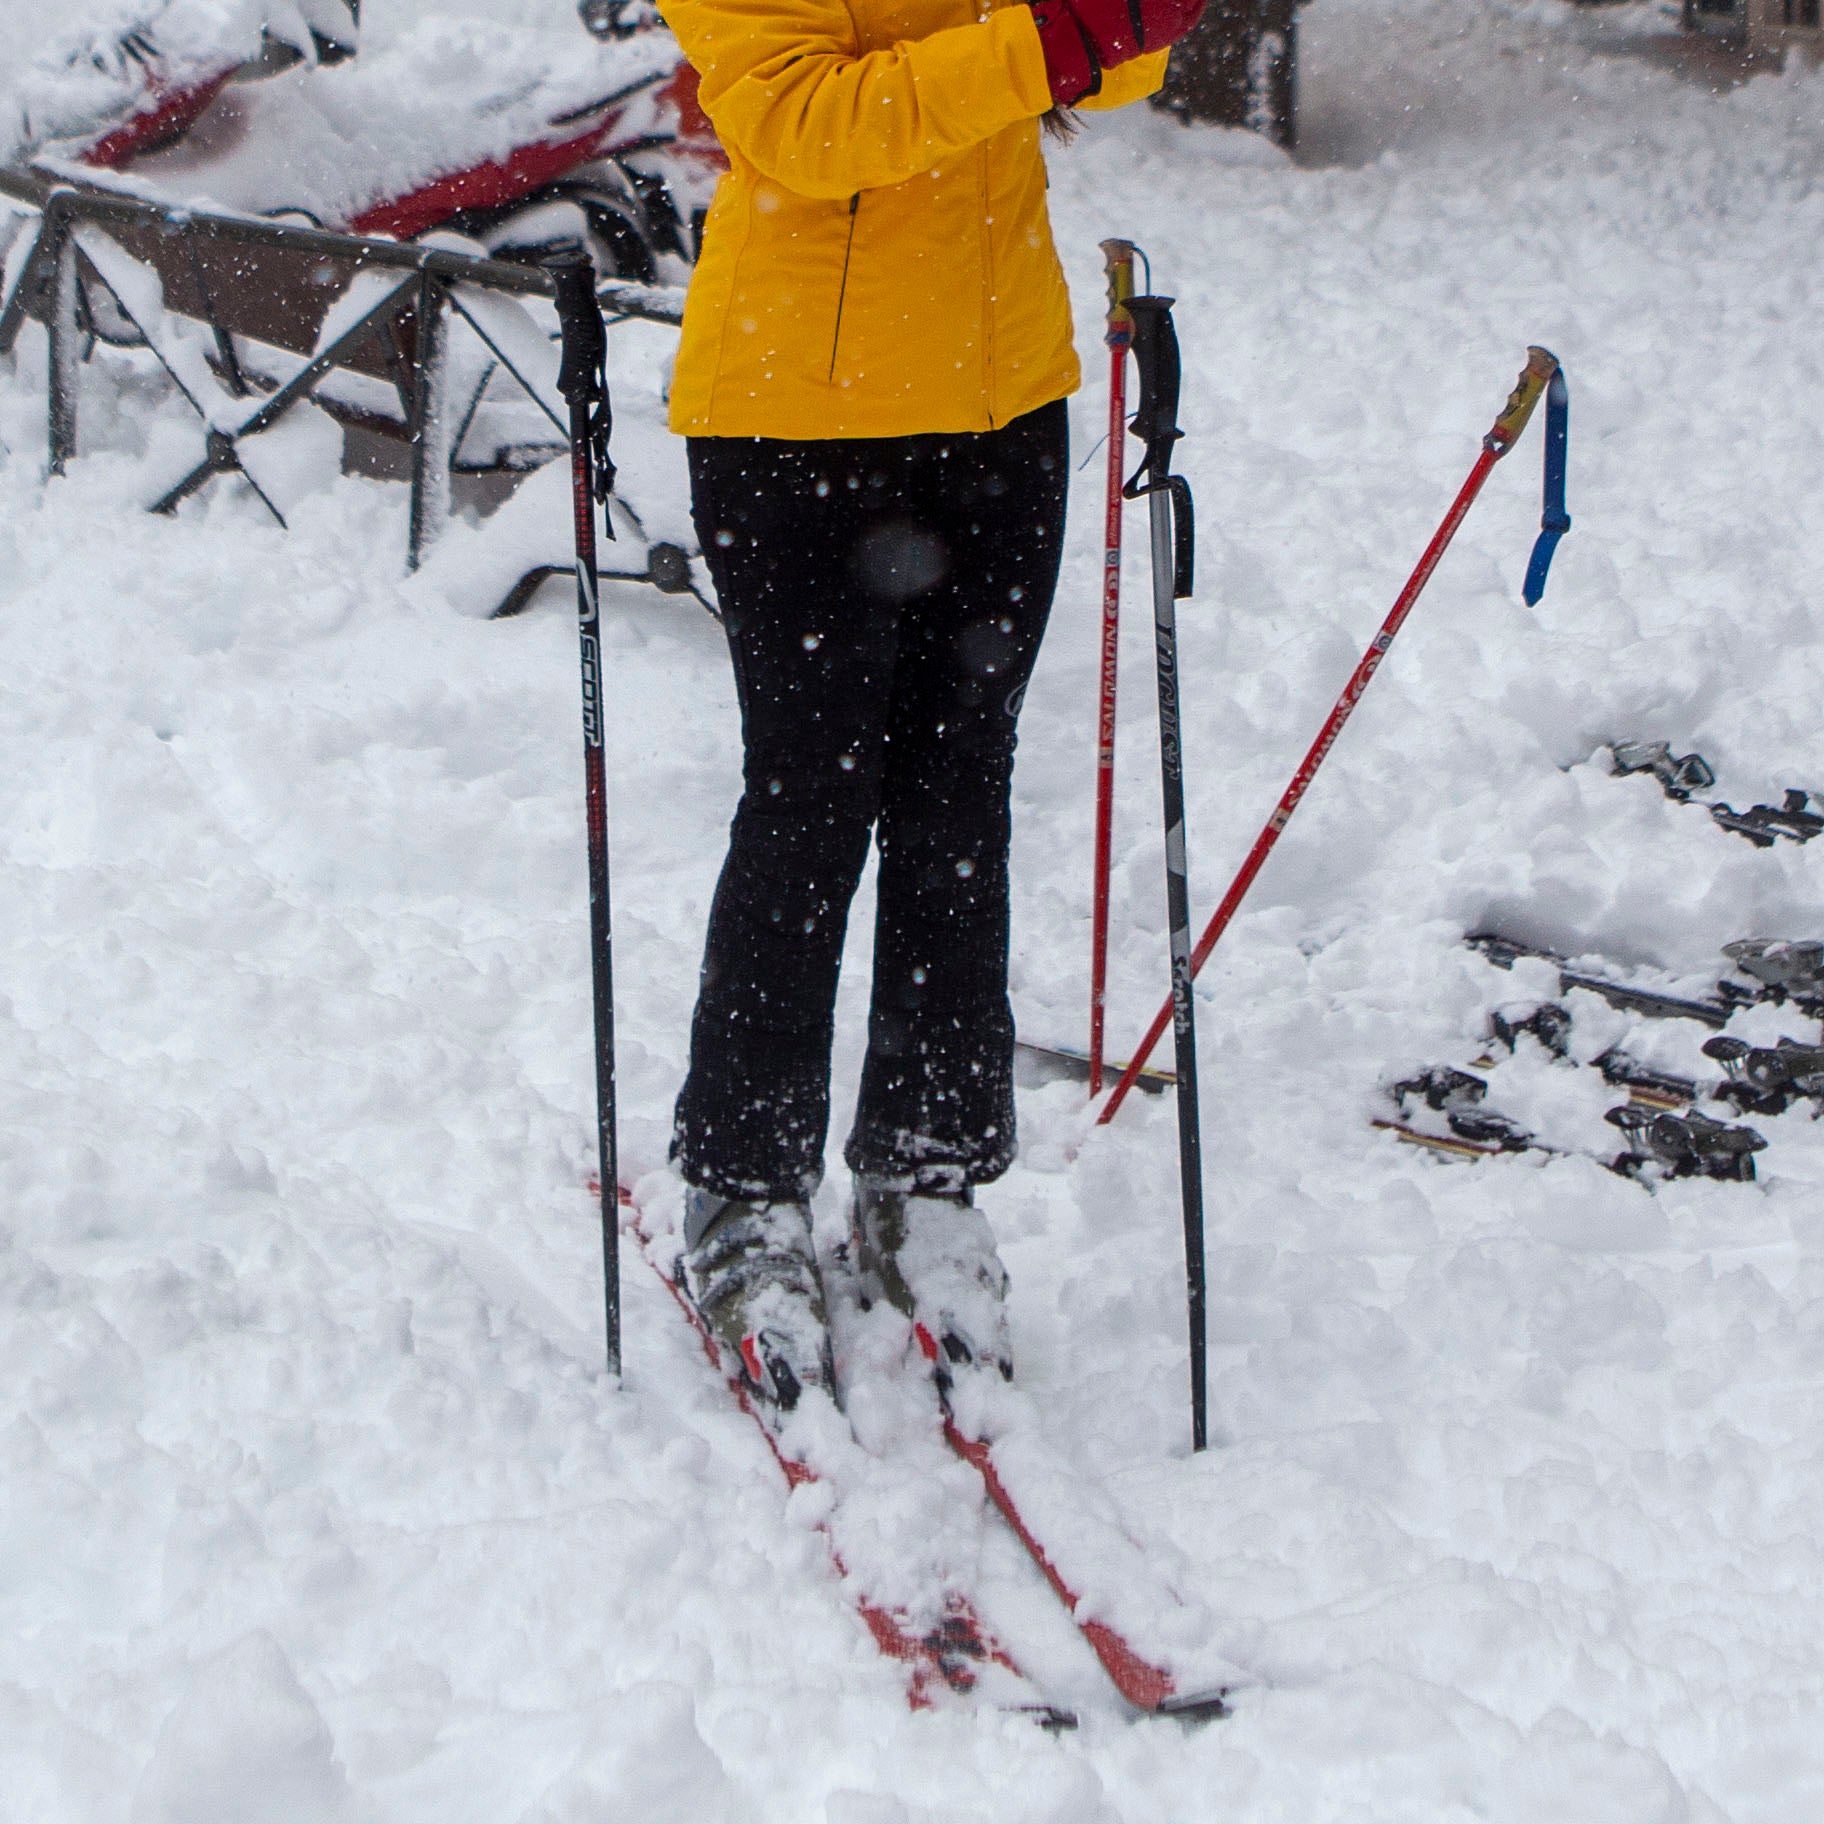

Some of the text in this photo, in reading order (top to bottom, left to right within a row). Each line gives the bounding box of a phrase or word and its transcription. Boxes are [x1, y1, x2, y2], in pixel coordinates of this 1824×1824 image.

[580, 633, 601, 748] SCOTT
[1102, 622, 1118, 743] SALOMON
[1288, 698, 1353, 808] SALOMON
